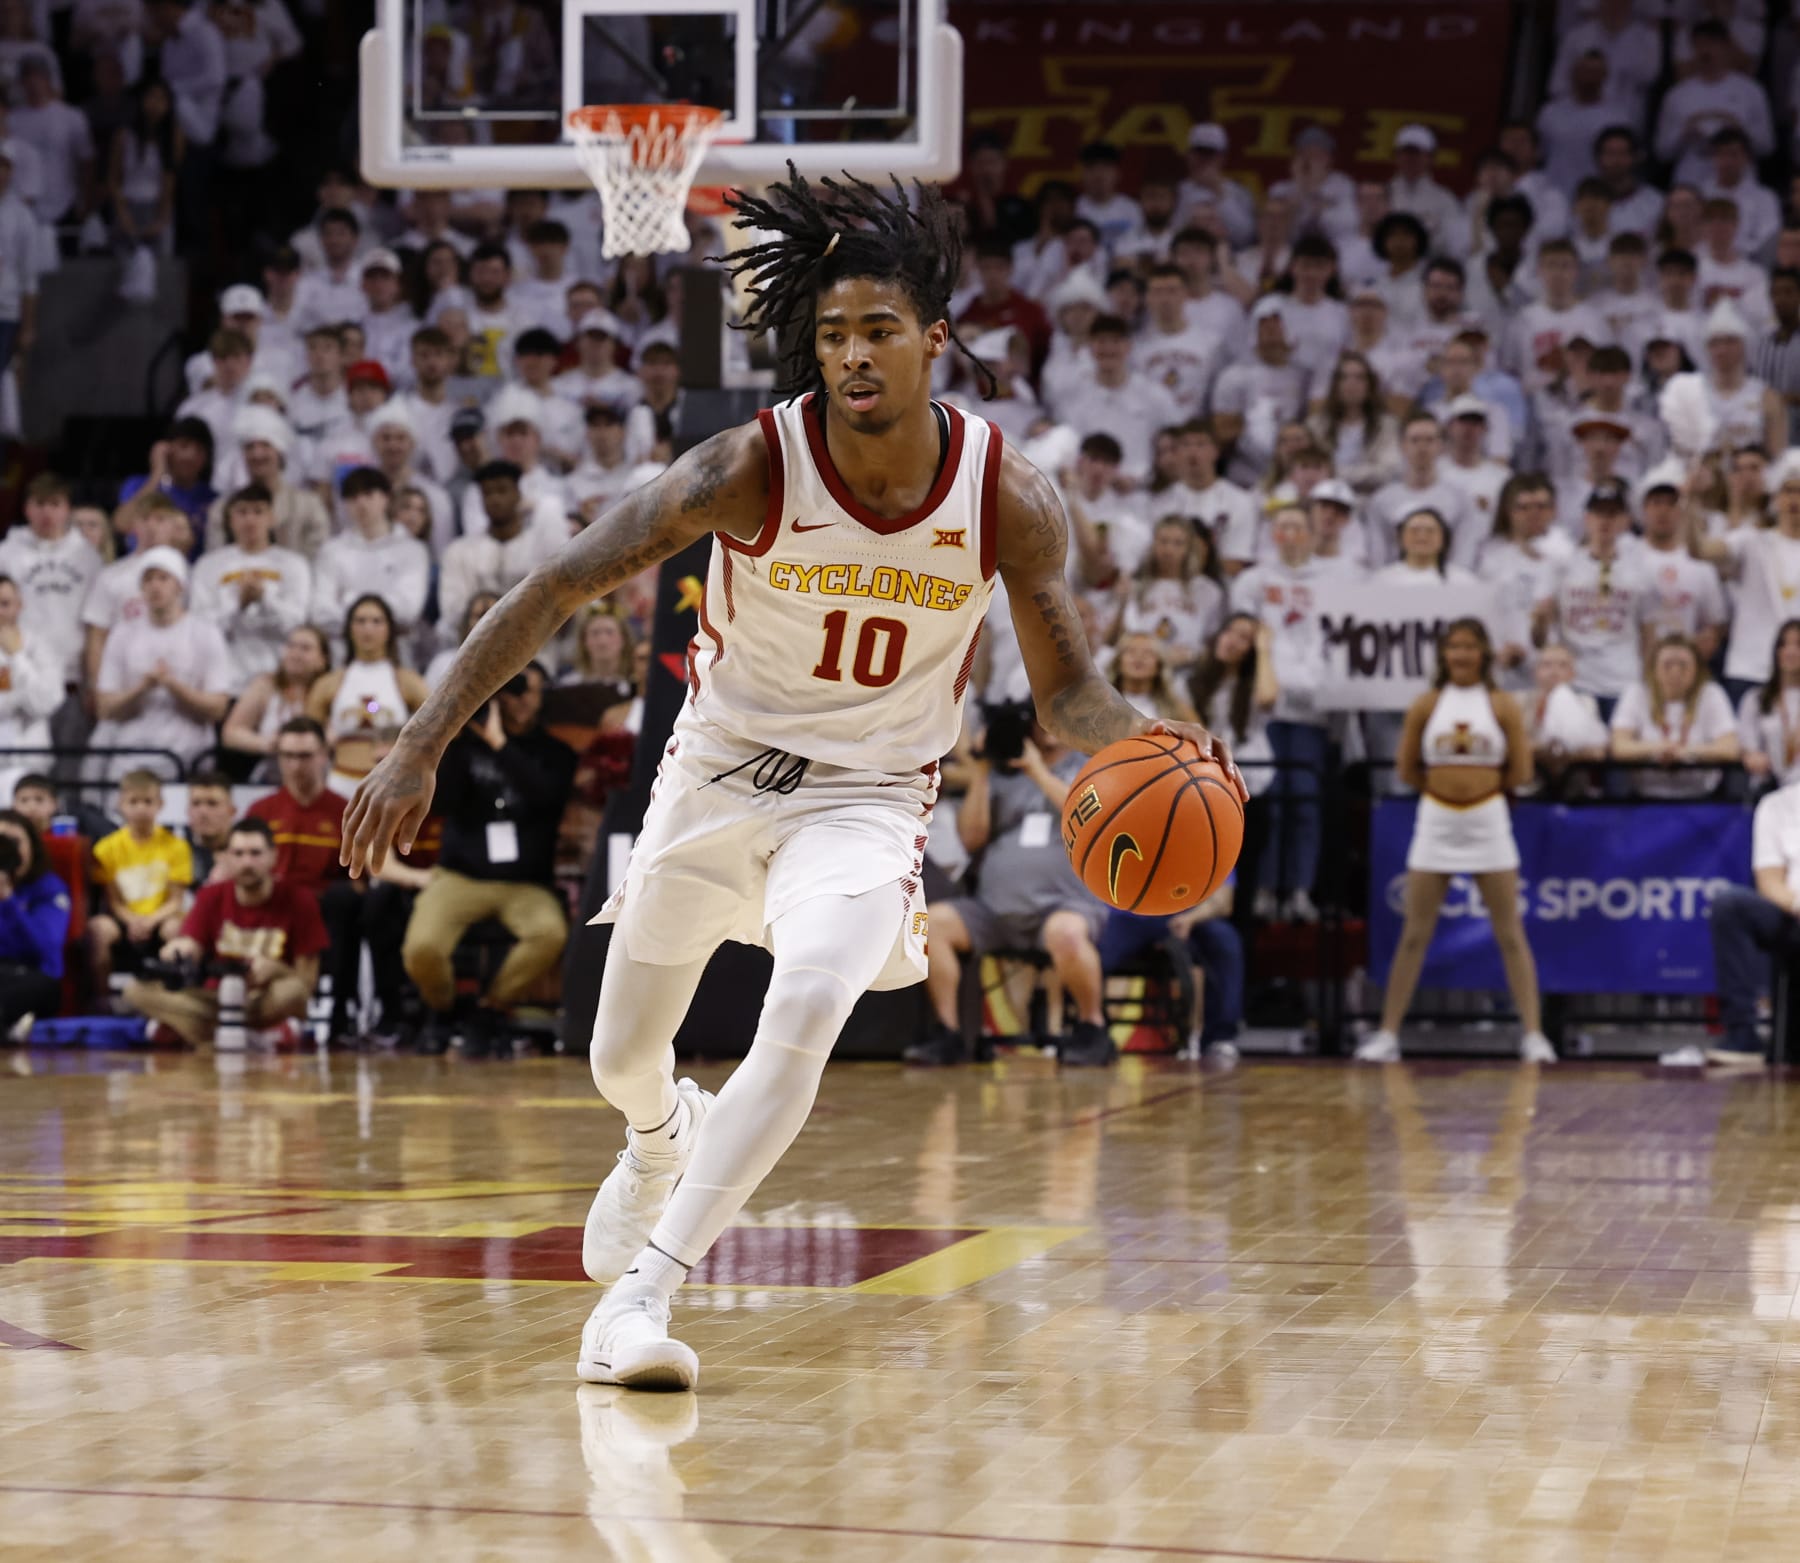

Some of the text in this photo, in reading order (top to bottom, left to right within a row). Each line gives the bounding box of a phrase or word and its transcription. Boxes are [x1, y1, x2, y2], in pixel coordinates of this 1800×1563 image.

[977, 15, 1477, 44] KINGLAND
[968, 104, 1466, 166] TATE
[932, 528, 966, 548] XII
[769, 561, 973, 611] CYCLONES
[811, 609, 908, 688] 10
[1536, 877, 1730, 921] SPORTS
